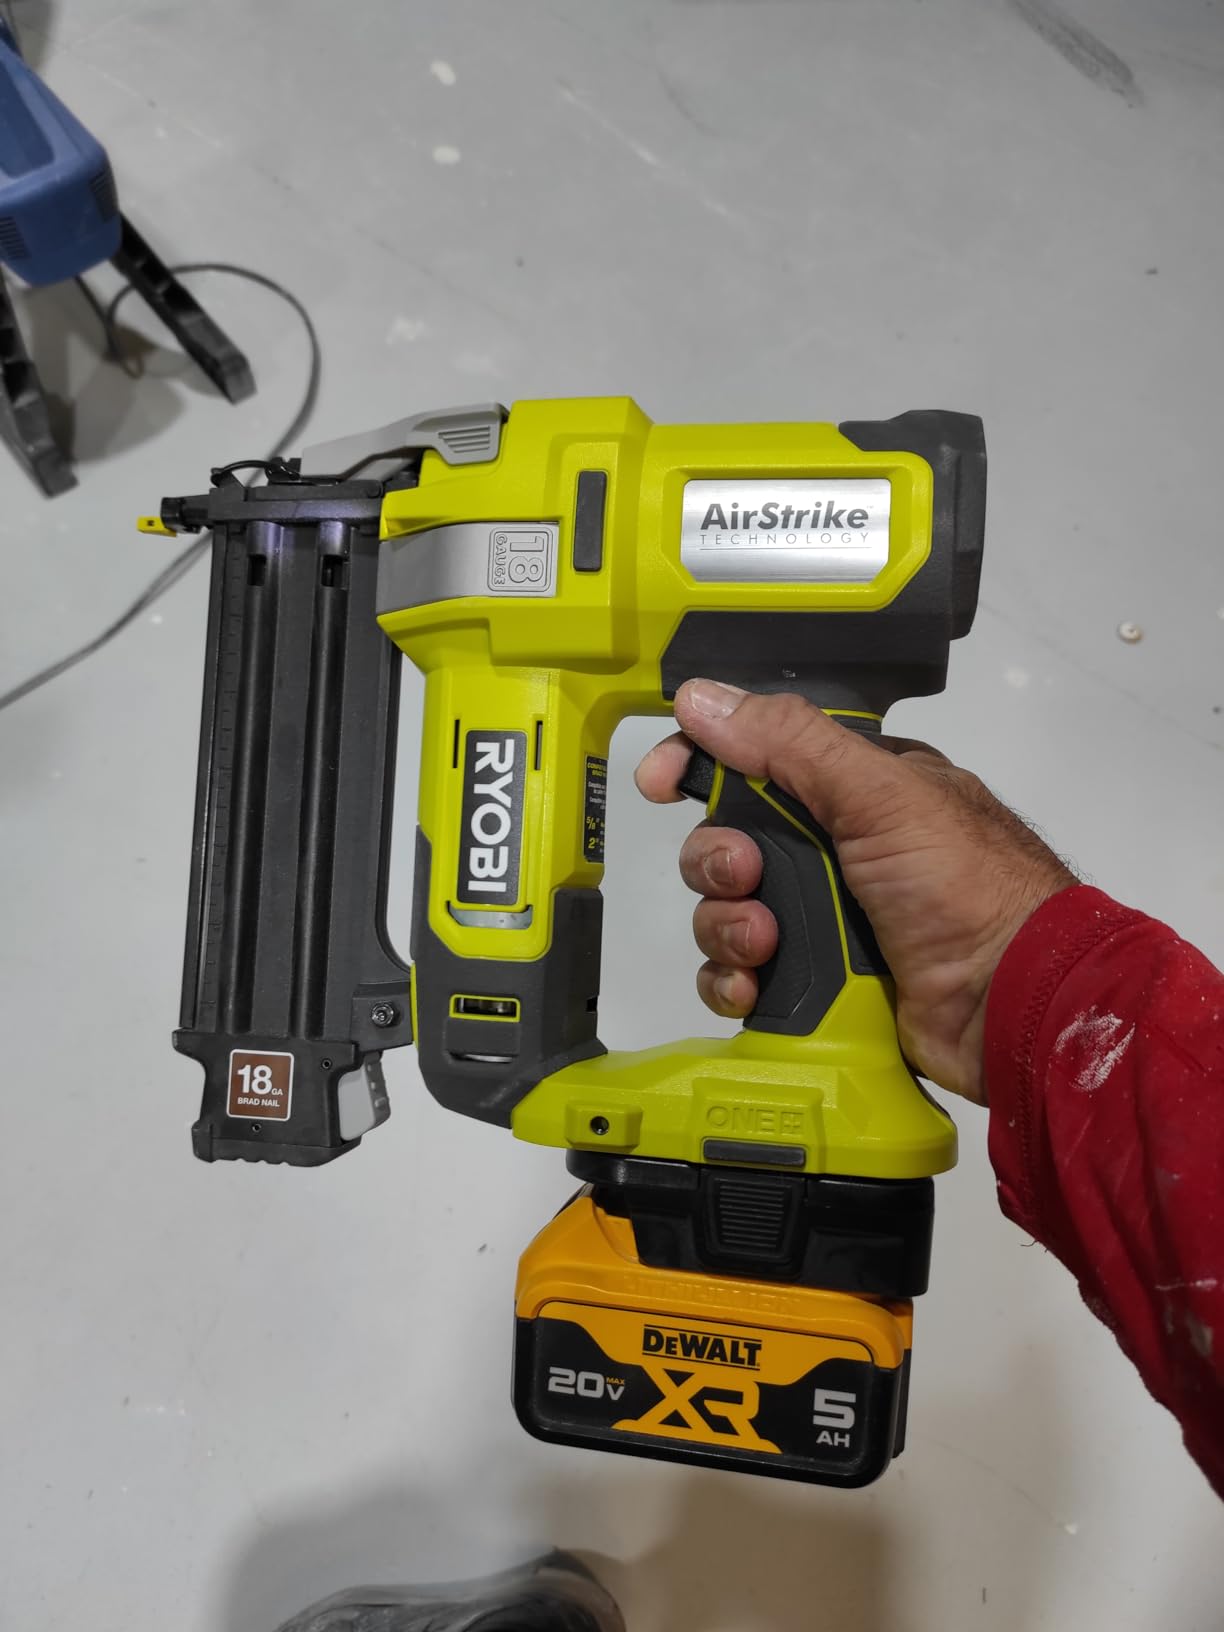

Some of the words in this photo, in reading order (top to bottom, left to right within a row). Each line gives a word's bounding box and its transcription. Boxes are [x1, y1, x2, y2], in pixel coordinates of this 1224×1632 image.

[700, 500, 869, 530] AirStrike
[700, 532, 869, 545] TECHNOLOGY
[494, 533, 507, 585] GAUGE
[508, 535, 545, 584] 18
[467, 738, 515, 893] RYOBI
[237, 1096, 260, 1106] BRAD
[261, 1098, 280, 1108] NAIL
[606, 1376, 625, 1386] MAX
[611, 1366, 783, 1455] XR
[813, 1388, 857, 1429] 5
[816, 1430, 850, 1448] AH
